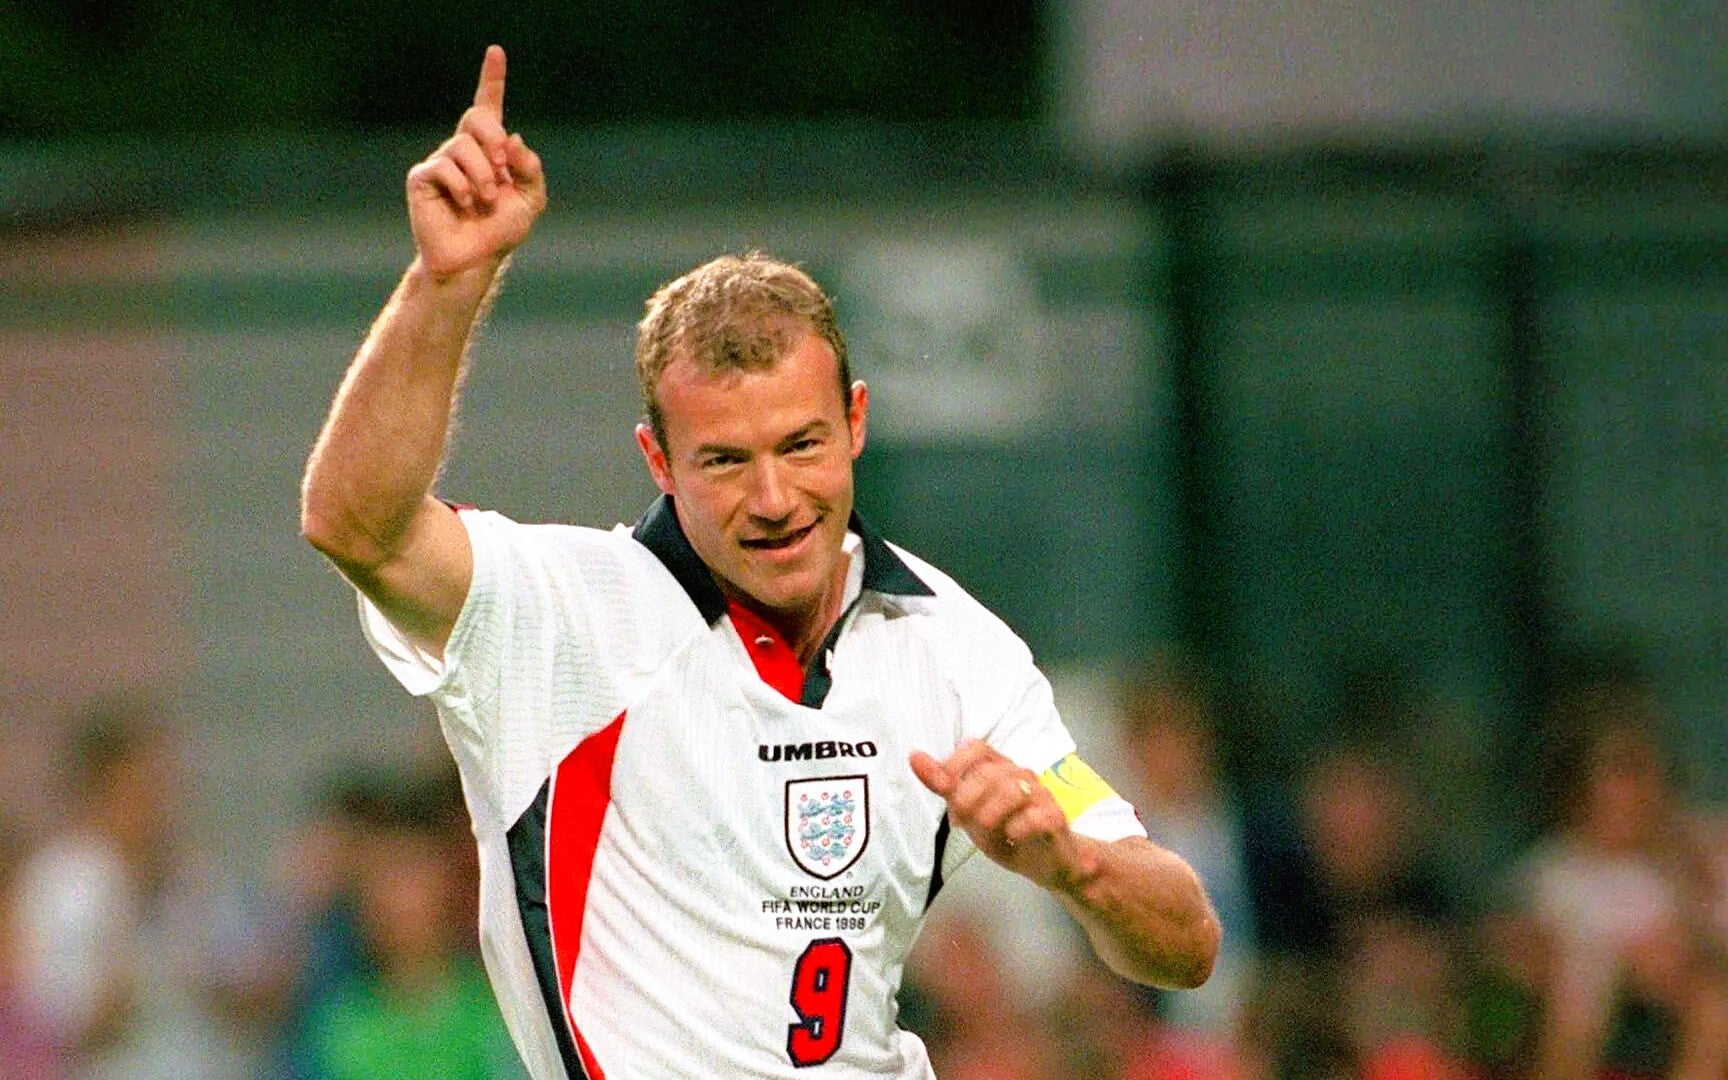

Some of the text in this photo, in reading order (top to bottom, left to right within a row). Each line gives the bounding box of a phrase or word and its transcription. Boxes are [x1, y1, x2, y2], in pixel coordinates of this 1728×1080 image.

[758, 740, 878, 762] UMBRO
[790, 885, 865, 898] ENGLAND
[761, 900, 881, 914] FIFA WORLD CUP
[775, 917, 866, 930] FRANCE 1998
[786, 937, 853, 1068] 9
